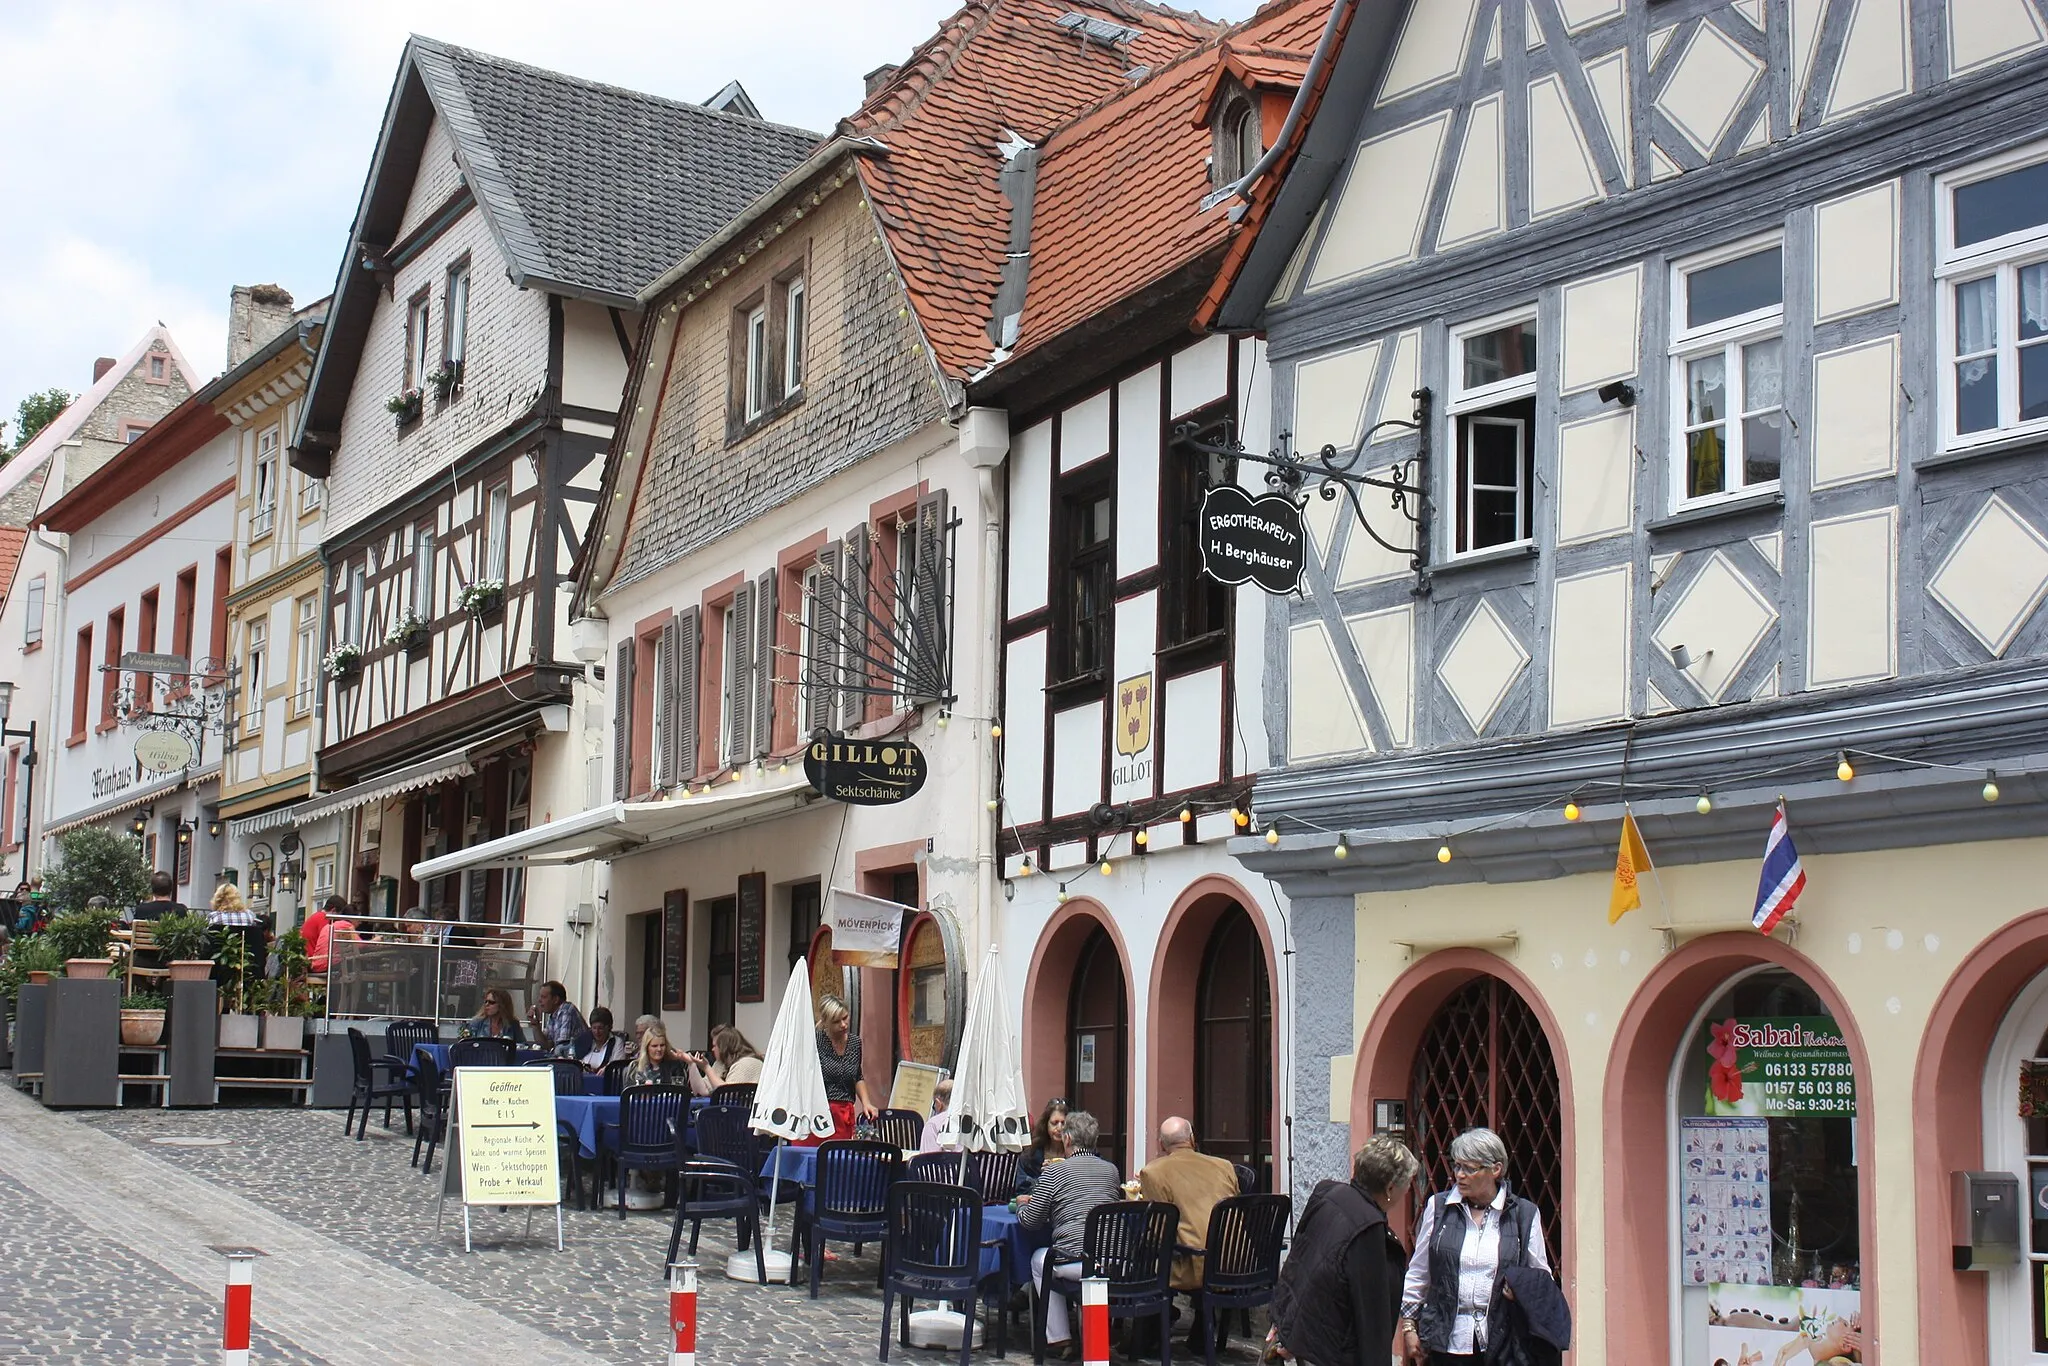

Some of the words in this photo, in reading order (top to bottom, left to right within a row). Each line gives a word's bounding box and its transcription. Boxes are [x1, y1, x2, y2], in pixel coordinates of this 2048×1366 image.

[1209, 514, 1296, 546] ERGOTHERAPEUT
[1211, 539, 1223, 556] H.
[1225, 542, 1293, 569] Berghäuser
[811, 742, 918, 766] GILLOT
[889, 767, 918, 776] HAUS
[1112, 759, 1153, 787] GILLOT
[92, 762, 132, 800] Weinhaus
[835, 784, 901, 799] Sektschänke
[837, 917, 896, 931] MÖVENPICK
[1732, 1023, 1802, 1048] Sabai
[1754, 1049, 1783, 1058] Wellness-
[1785, 1050, 1790, 1058] &
[1765, 1063, 1806, 1076] 06133
[489, 1081, 523, 1092] Geöffnet
[1765, 1082, 1795, 1095] 0157
[1799, 1082, 1814, 1095] 56
[1817, 1082, 1833, 1095] 03
[1836, 1082, 1852, 1095] 86
[482, 1097, 499, 1105] Kaffee
[508, 1097, 529, 1105] Kuchen
[1765, 1098, 1806, 1111] Mo-Sa:
[483, 1135, 512, 1145] Regionale
[515, 1135, 532, 1144] Küche
[525, 1148, 546, 1157] Speisen
[471, 1162, 490, 1172] Wein
[500, 1162, 548, 1173] Sektschoppen
[479, 1177, 501, 1187] Probe
[516, 1177, 543, 1187] Verkauf
